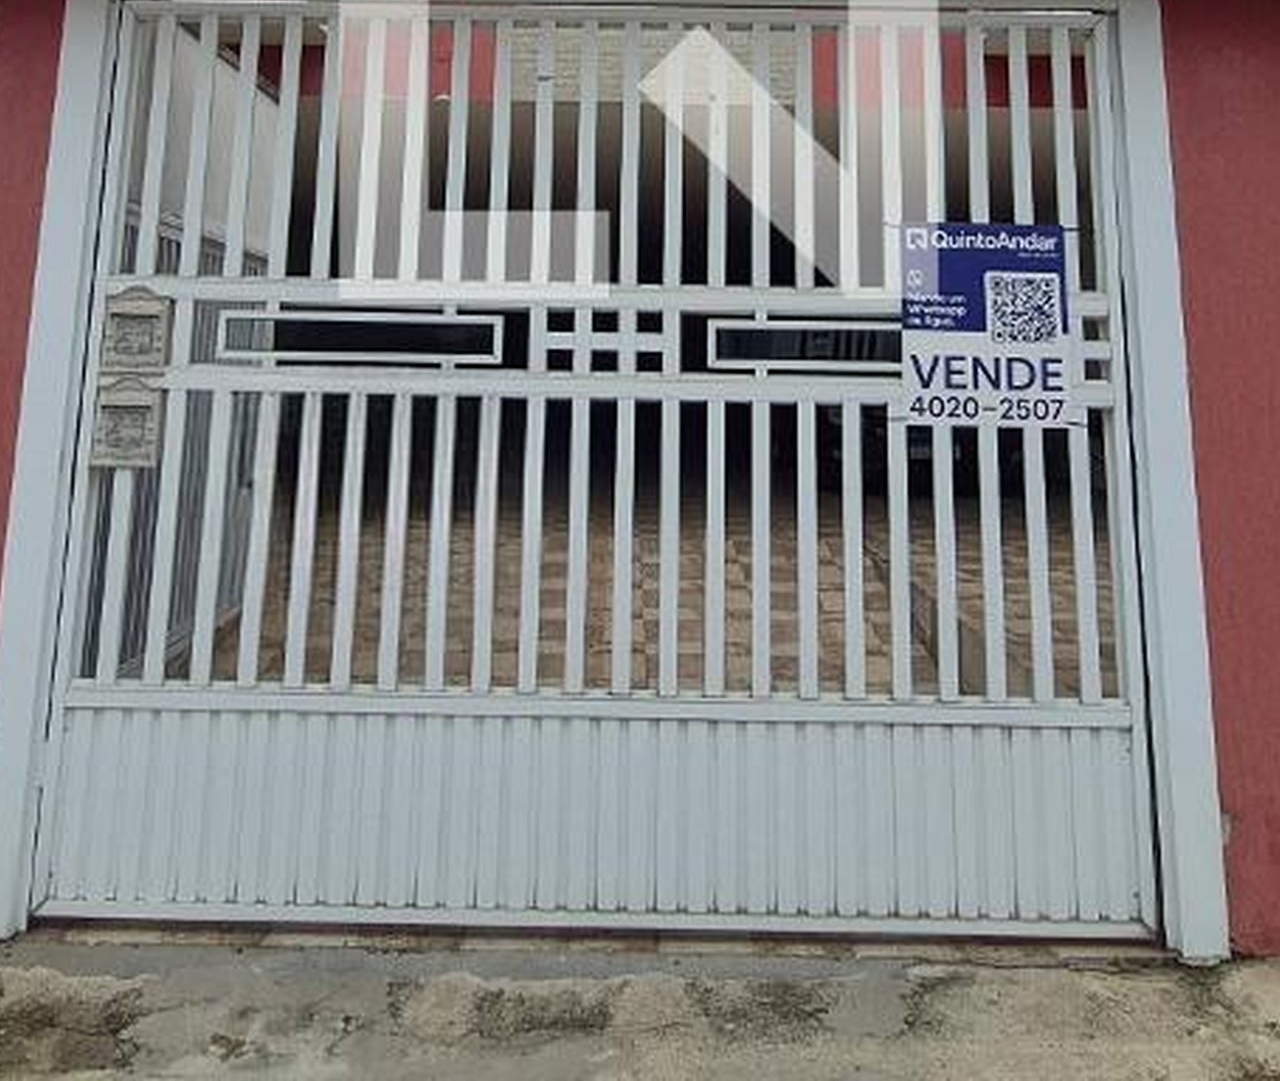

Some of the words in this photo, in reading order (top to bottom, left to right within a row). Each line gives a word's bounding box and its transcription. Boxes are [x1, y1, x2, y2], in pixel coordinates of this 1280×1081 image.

[931, 229, 1058, 252] QuintoAndar
[910, 353, 1064, 392] VENDE
[908, 395, 1064, 420] 4020-2507
